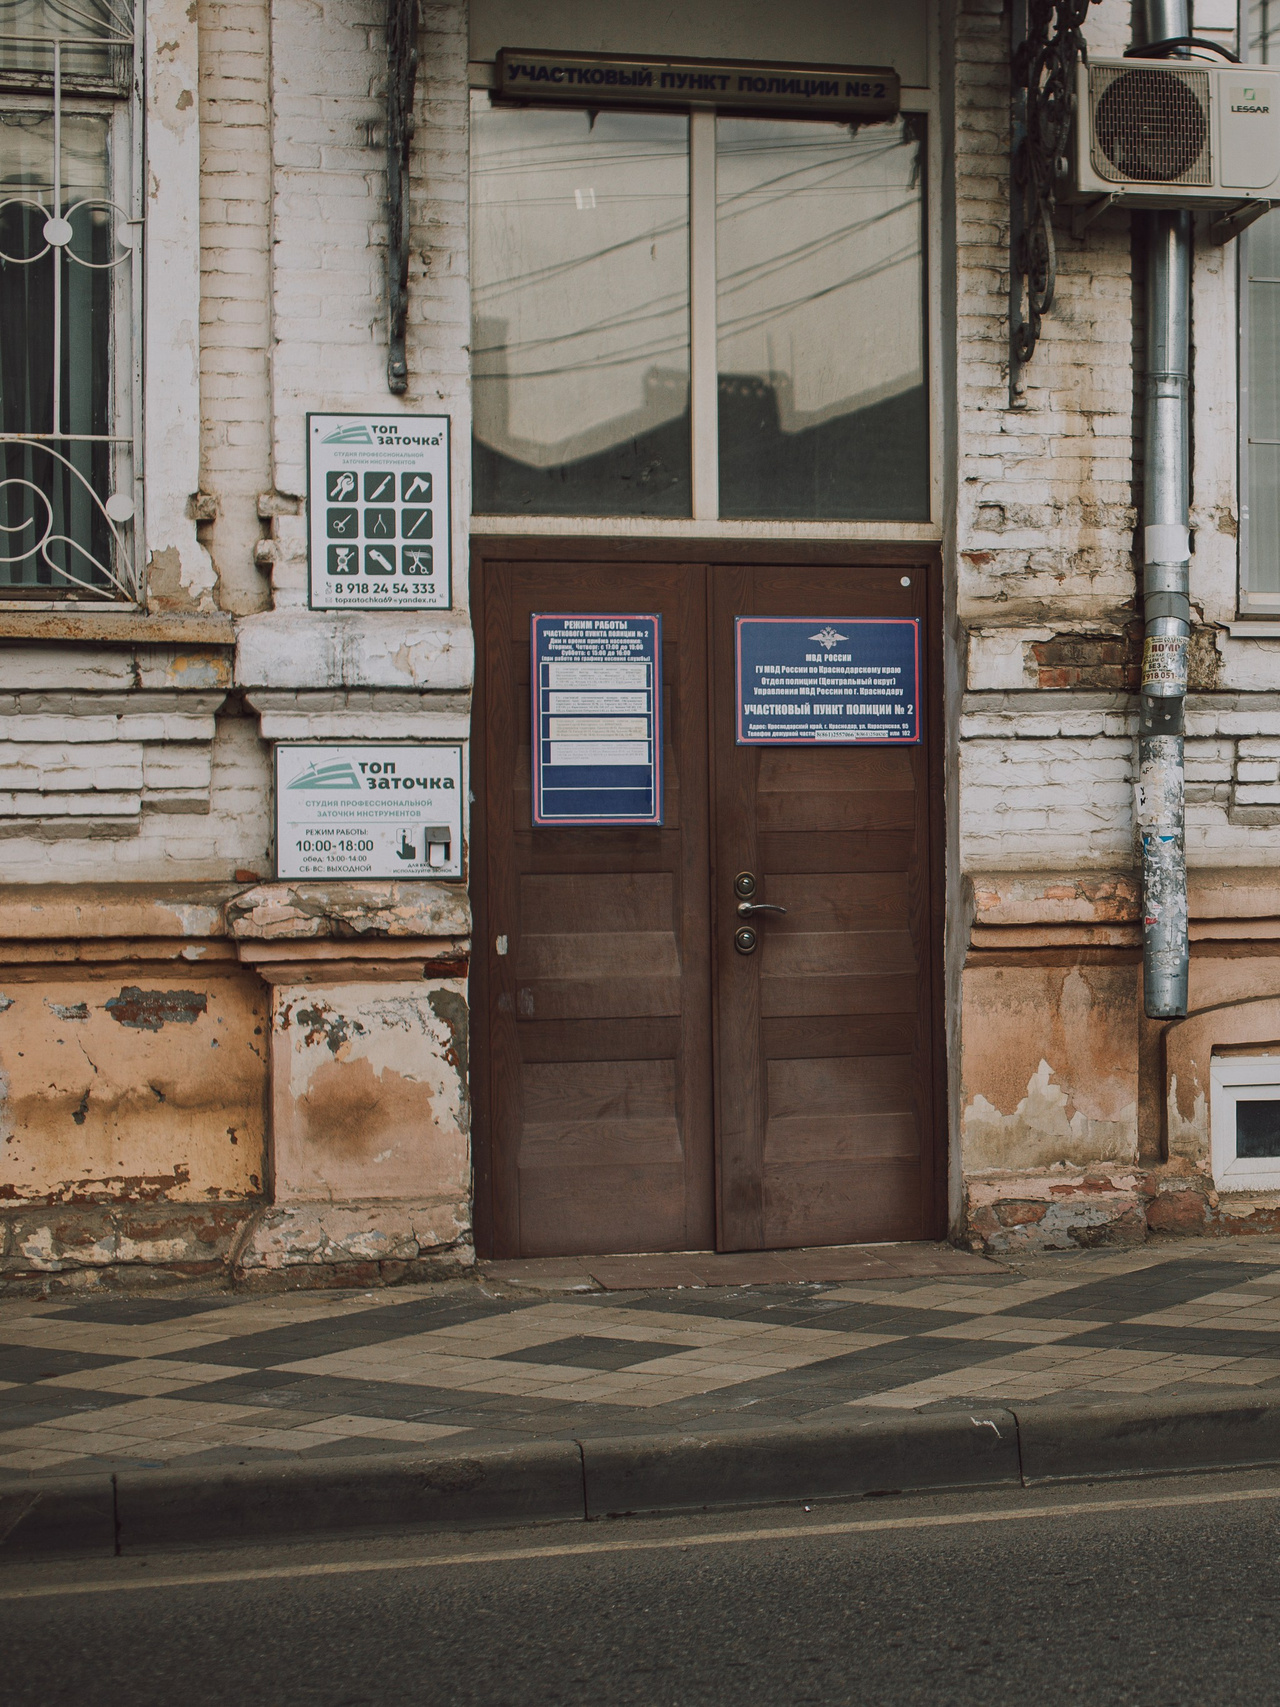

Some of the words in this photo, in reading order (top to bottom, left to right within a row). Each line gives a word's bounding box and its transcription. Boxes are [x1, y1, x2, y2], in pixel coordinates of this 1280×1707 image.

[507, 63, 653, 88] УЧАСТКОВЫЙ
[660, 71, 730, 92] ПУНКТ
[738, 75, 839, 98] ПОЛИЦИИ
[1231, 105, 1270, 113] LESSAR
[335, 583, 343, 594] 8
[347, 583, 369, 594] 918
[373, 583, 389, 594] 24
[392, 583, 409, 594] 54
[412, 583, 435, 594] 333
[564, 621, 592, 629] РЕЖИМ
[594, 621, 628, 629] РАБОТЫ
[806, 654, 822, 662] МВД
[824, 654, 852, 662] РОССИИ
[756, 665, 763, 674] ГУ
[764, 665, 781, 674] МВД
[782, 665, 808, 674] России
[809, 665, 818, 674] по
[819, 665, 881, 674] Краснодарскому
[882, 665, 901, 674] краю
[761, 677, 784, 686] Отдел
[785, 677, 818, 686] полиции
[754, 687, 798, 696] Управления
[800, 687, 816, 696] МВД
[816, 687, 843, 696] России
[844, 687, 853, 696] по
[860, 687, 903, 696] Краснодару
[744, 702, 810, 715] УЧАСТКОВЫЙ
[813, 704, 844, 715] ПУНКТ
[846, 704, 892, 716] ПОЛИЦИИ
[894, 705, 904, 715] №
[907, 705, 913, 715] 2
[341, 799, 432, 807] ПРОФЕССИОНАЛЬНОЙ
[327, 864, 371, 872] ВЫХОДНОЙ
